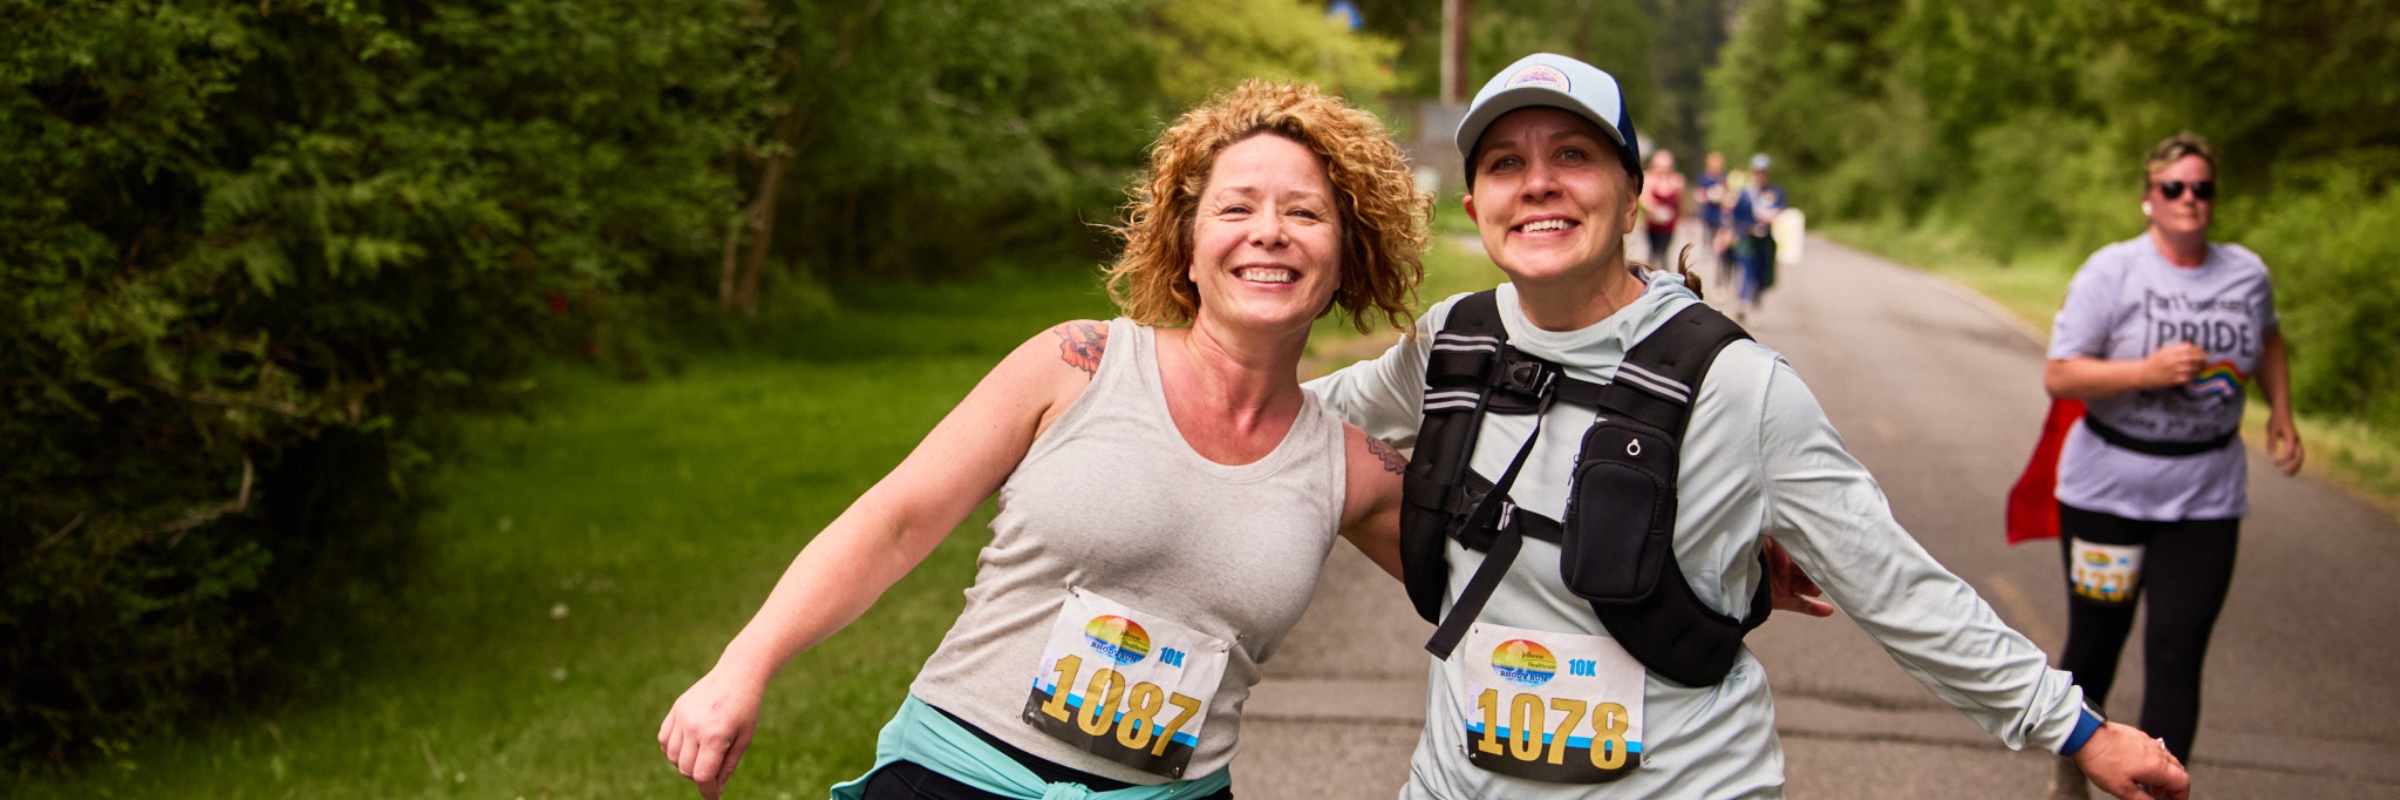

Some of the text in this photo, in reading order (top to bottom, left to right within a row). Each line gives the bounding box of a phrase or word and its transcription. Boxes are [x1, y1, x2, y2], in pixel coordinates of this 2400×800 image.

[2157, 318, 2253, 357] PRIDE
[1159, 646, 1185, 668] 10K
[1568, 659, 1596, 677] 10K
[1500, 670, 1528, 680] RHODY
[1529, 674, 1547, 682] RUN
[1041, 654, 1201, 757] 1087
[1478, 688, 1629, 770] 1078
